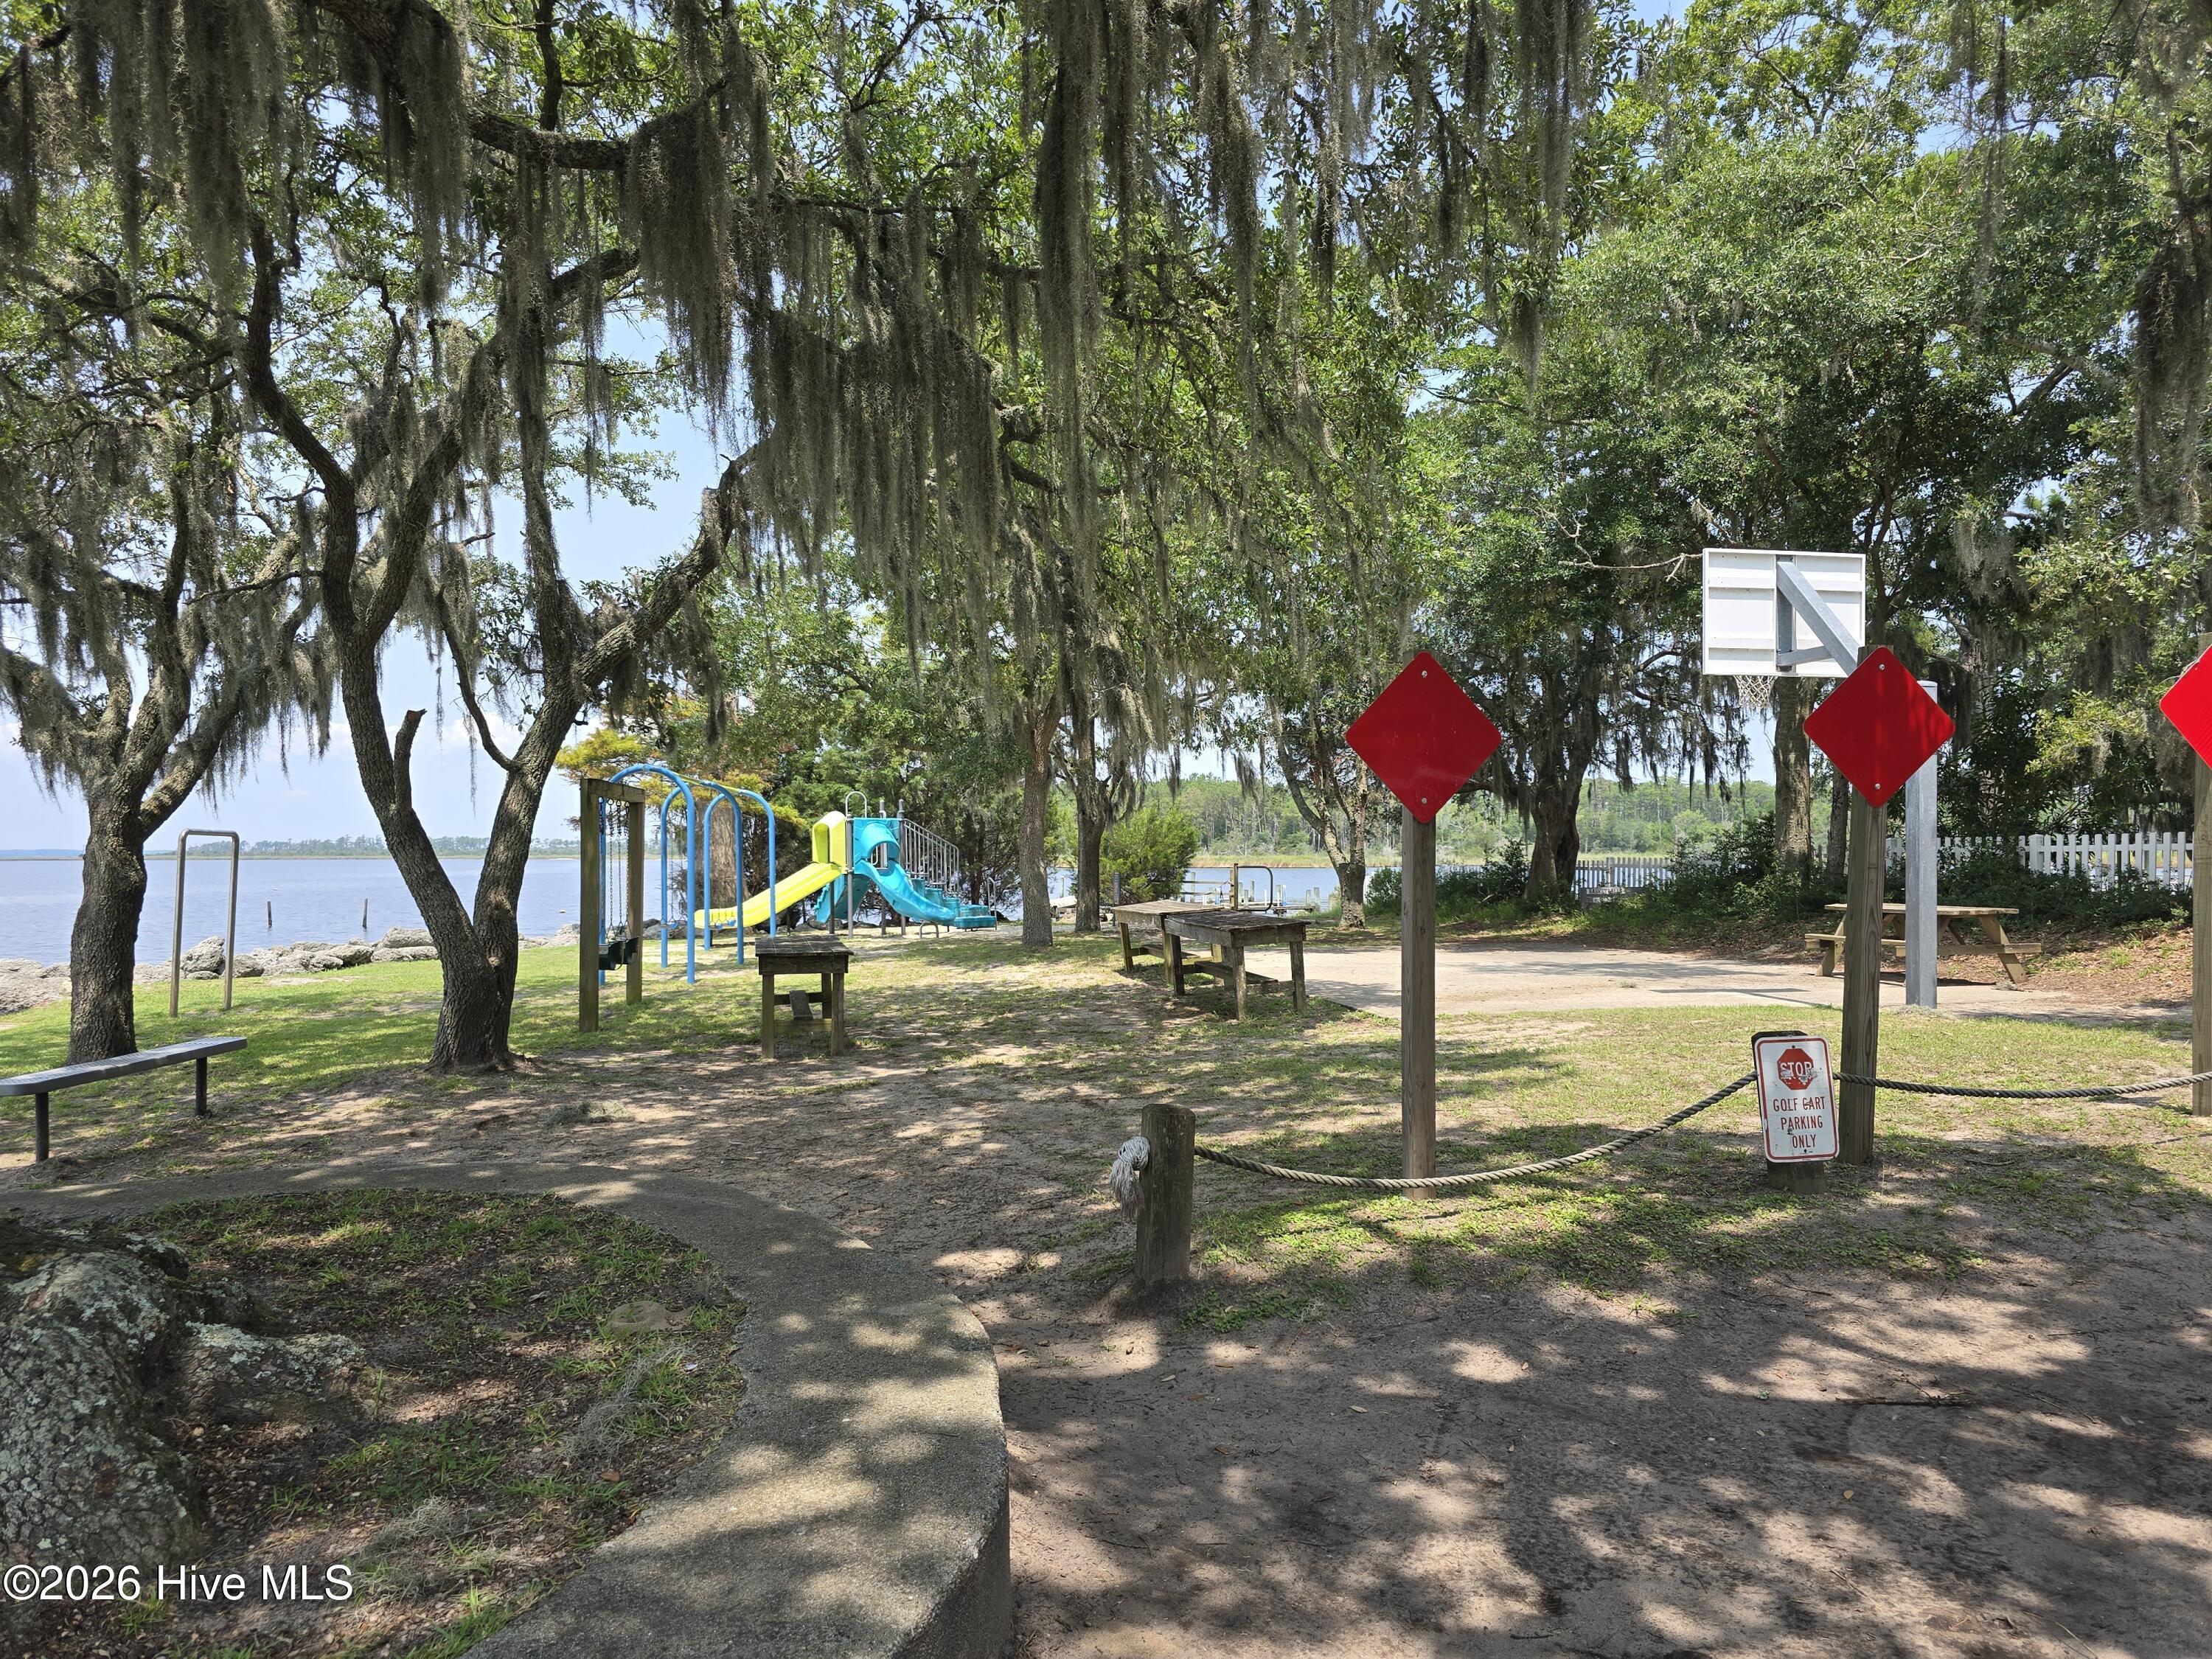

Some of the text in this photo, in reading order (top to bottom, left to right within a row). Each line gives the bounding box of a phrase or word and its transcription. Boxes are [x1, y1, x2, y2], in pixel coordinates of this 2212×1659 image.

[1780, 1062, 1812, 1078] STOP
[1773, 1096, 1825, 1112] GOLF CART
[1781, 1115, 1823, 1130] PARKING
[1792, 1134, 1816, 1148] ONLY
